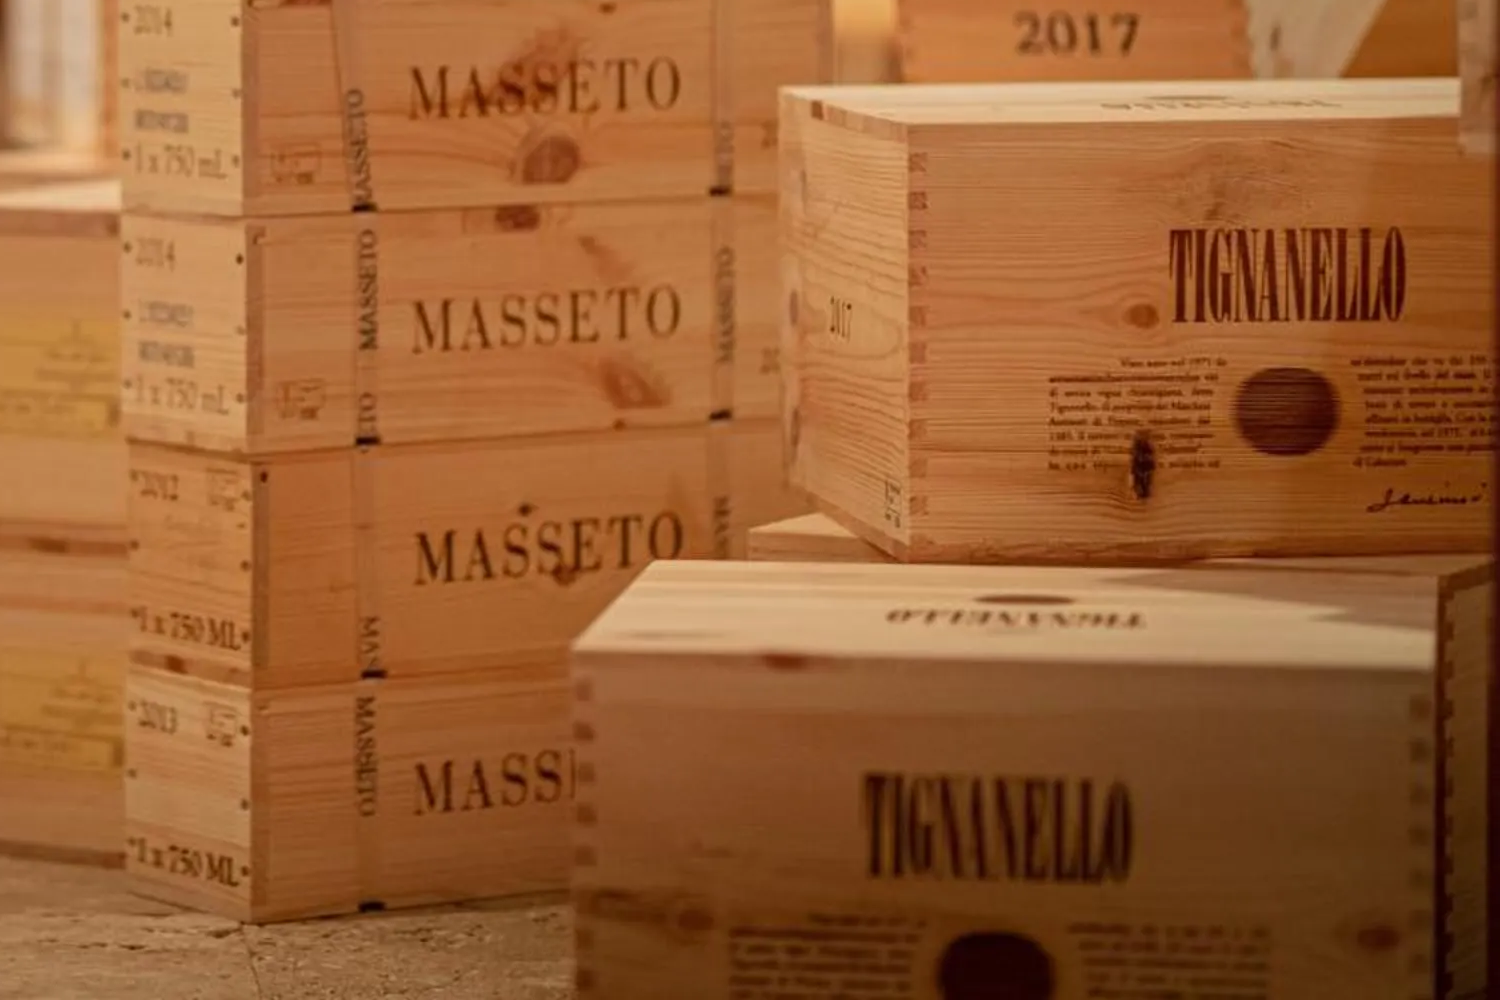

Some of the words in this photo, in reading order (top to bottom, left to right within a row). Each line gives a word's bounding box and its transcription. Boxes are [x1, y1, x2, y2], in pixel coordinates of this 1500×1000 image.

[1011, 10, 1143, 58] 2017
[408, 56, 681, 121] MASSETO
[357, 227, 379, 351] MASSETO
[1169, 226, 1406, 323] TIGNANELLO
[410, 284, 681, 355] MASSETO
[413, 511, 683, 585] MASSETO
[356, 696, 379, 817] MASSETO
[413, 748, 577, 816] MASS
[859, 772, 1133, 884] TIGNANELLO
